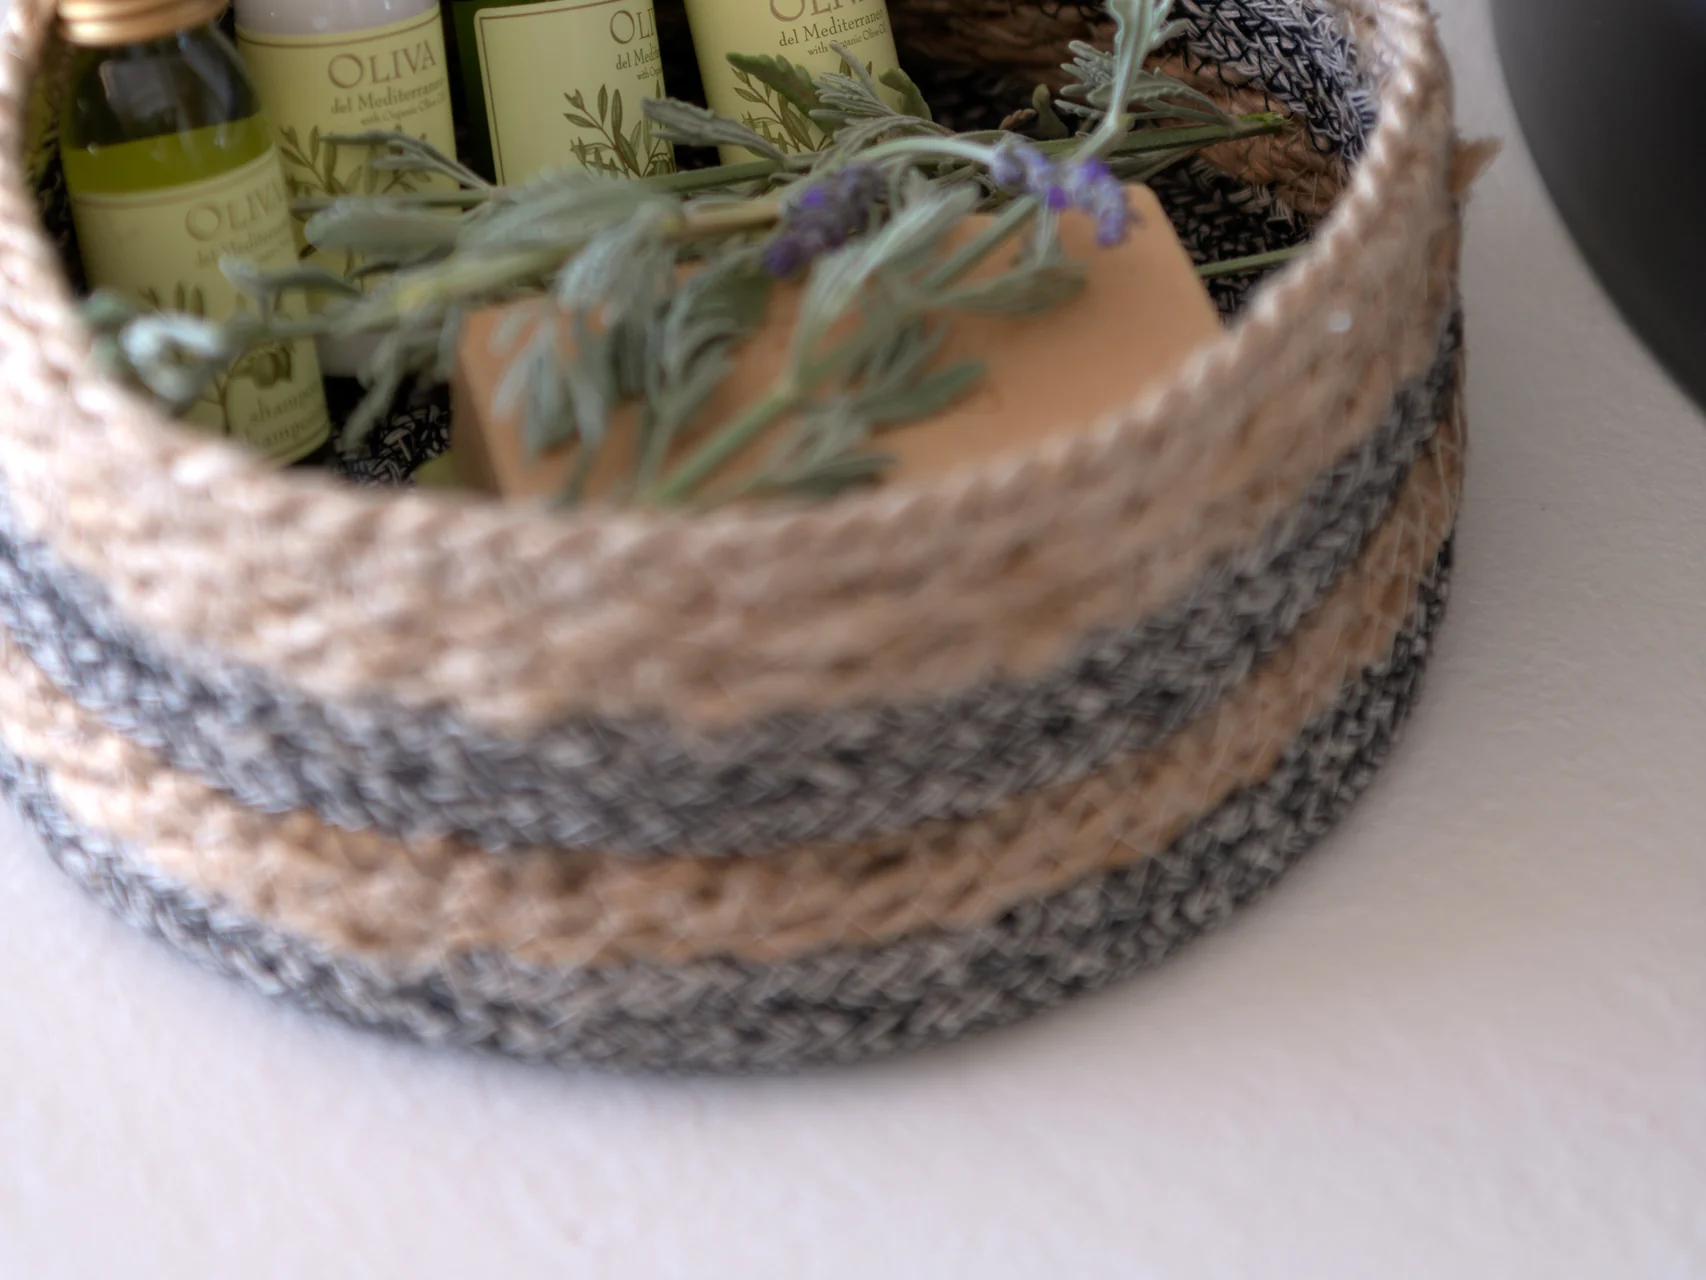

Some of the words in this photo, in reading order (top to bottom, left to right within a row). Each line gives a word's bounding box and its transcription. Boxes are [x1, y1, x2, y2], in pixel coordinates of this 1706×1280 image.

[779, 29, 799, 47] del
[807, 41, 829, 56] with
[327, 39, 437, 90] OLIVA
[616, 53, 632, 70] del
[331, 96, 352, 115] del
